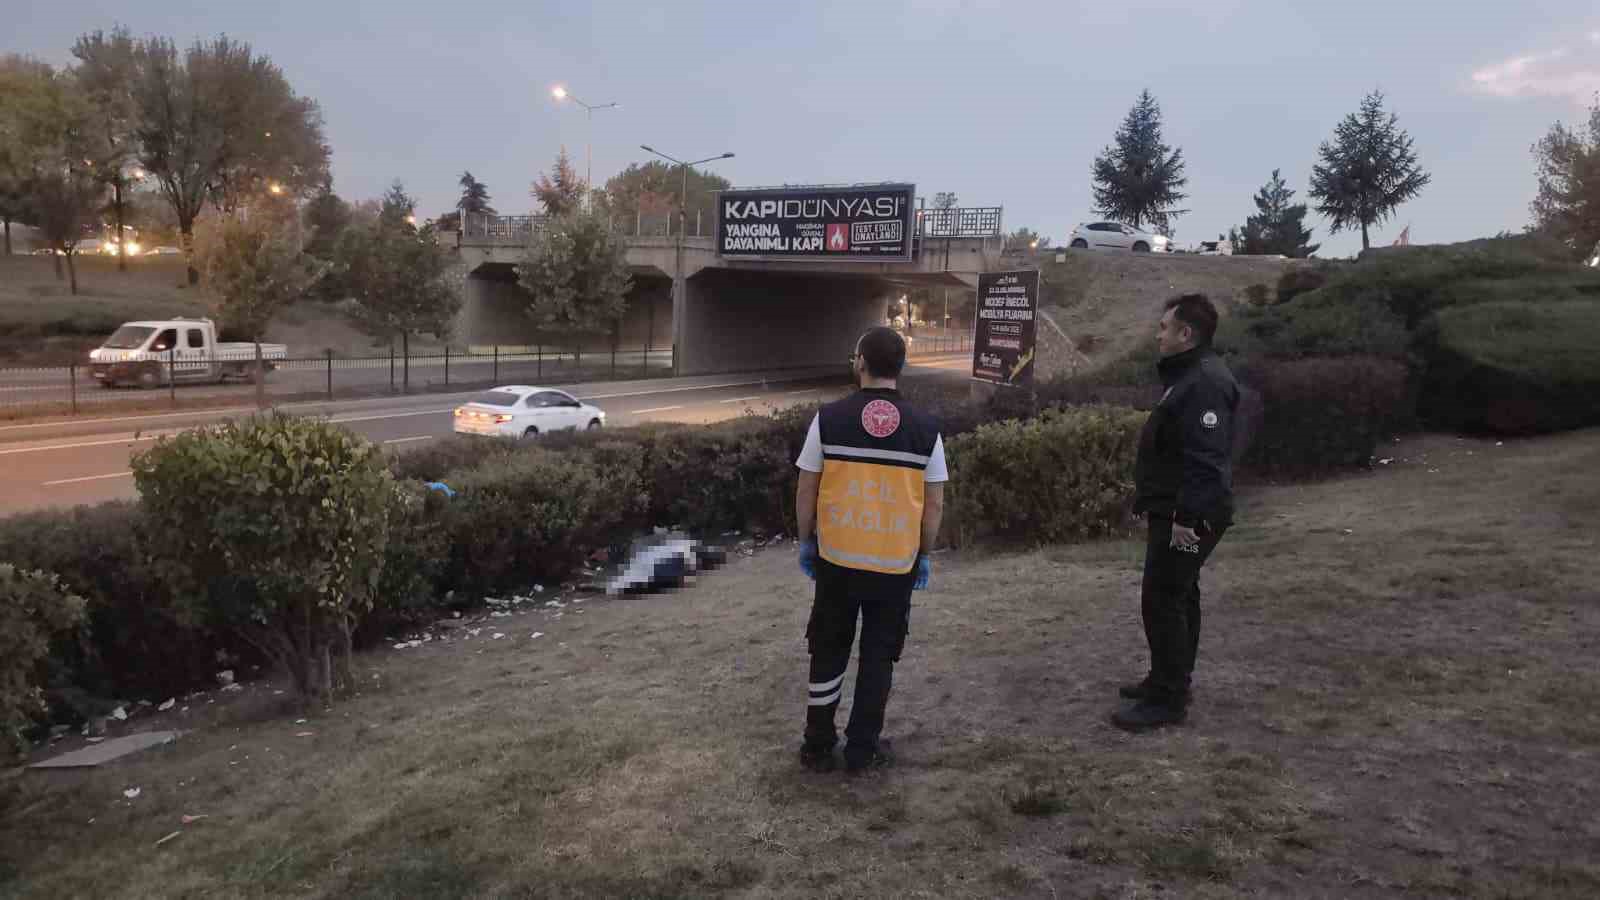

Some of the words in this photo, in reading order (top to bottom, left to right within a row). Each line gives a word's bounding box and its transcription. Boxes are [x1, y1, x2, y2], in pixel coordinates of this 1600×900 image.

[726, 224, 780, 236] YANGINA
[855, 224, 872, 232] TEST
[725, 237, 789, 250] DAYANIMLI
[793, 237, 824, 250] KAPI
